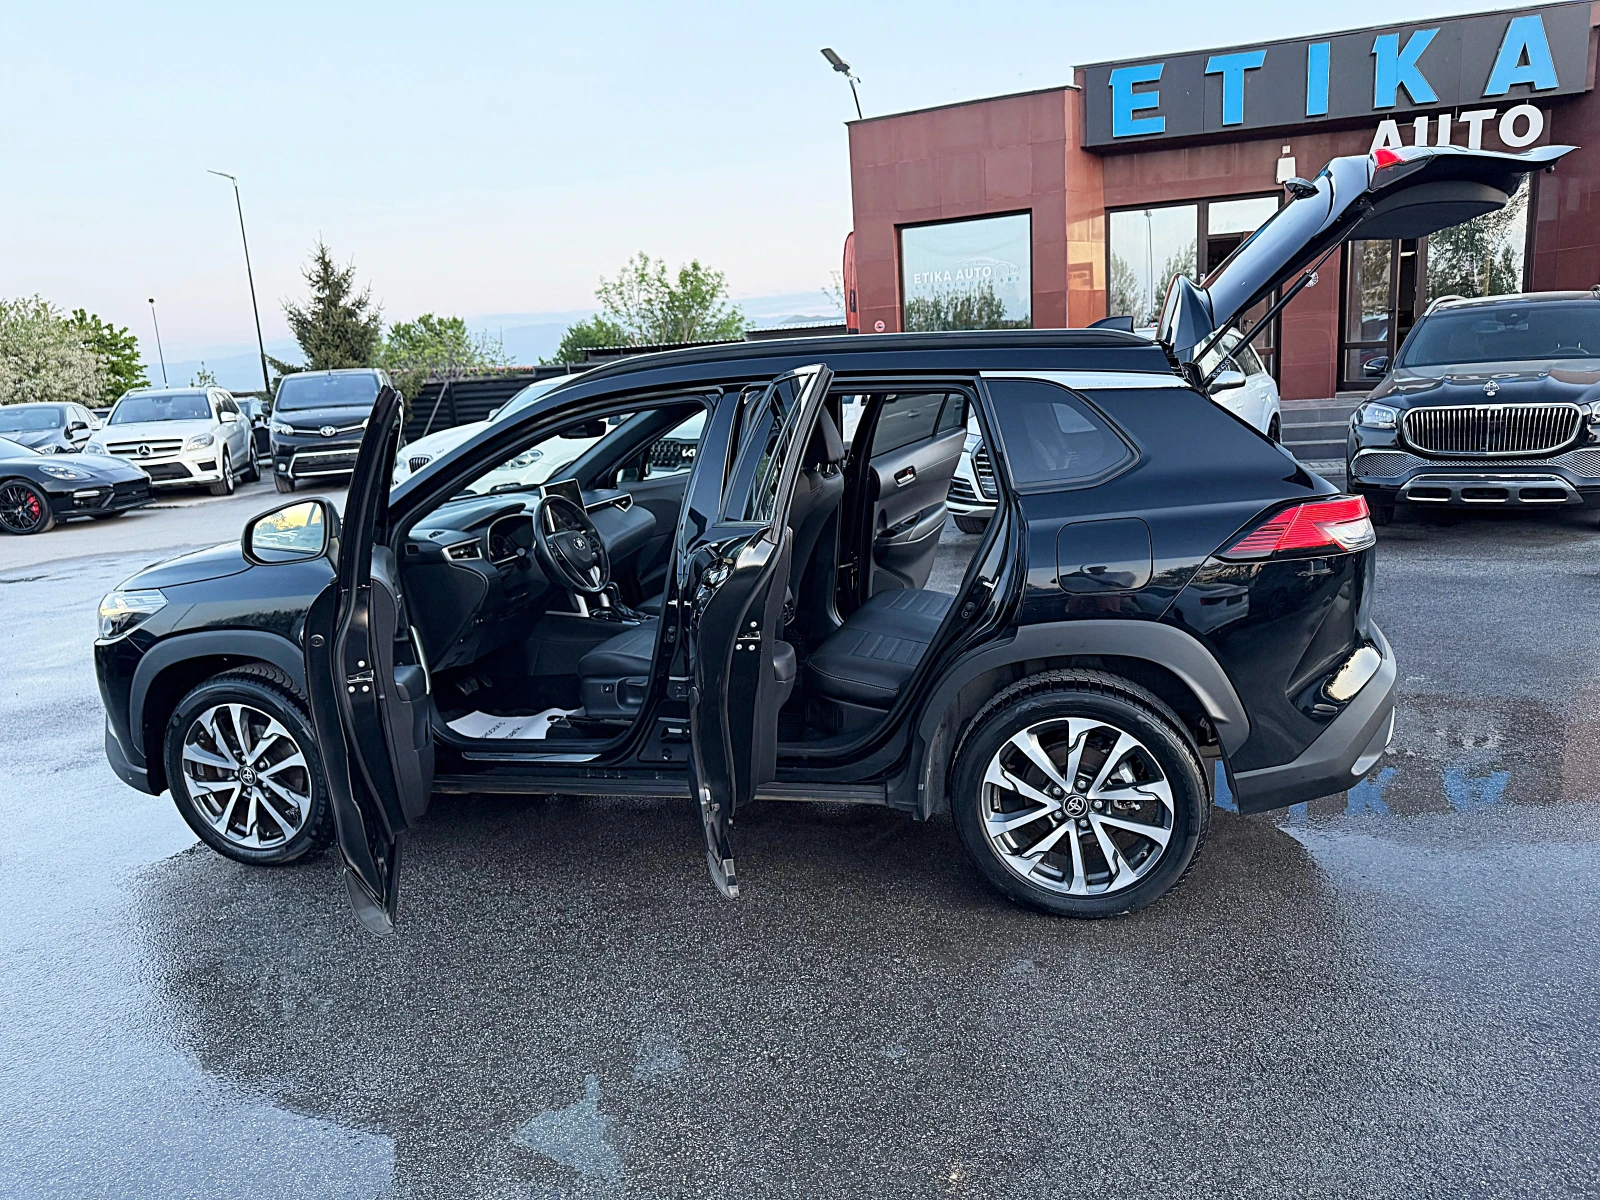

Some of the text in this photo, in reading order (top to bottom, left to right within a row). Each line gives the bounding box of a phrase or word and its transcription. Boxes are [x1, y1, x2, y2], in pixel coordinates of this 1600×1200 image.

[1109, 14, 1559, 138] ETIKA
[1370, 104, 1544, 153] AUTO
[914, 266, 992, 284] ETIKA AUTO
